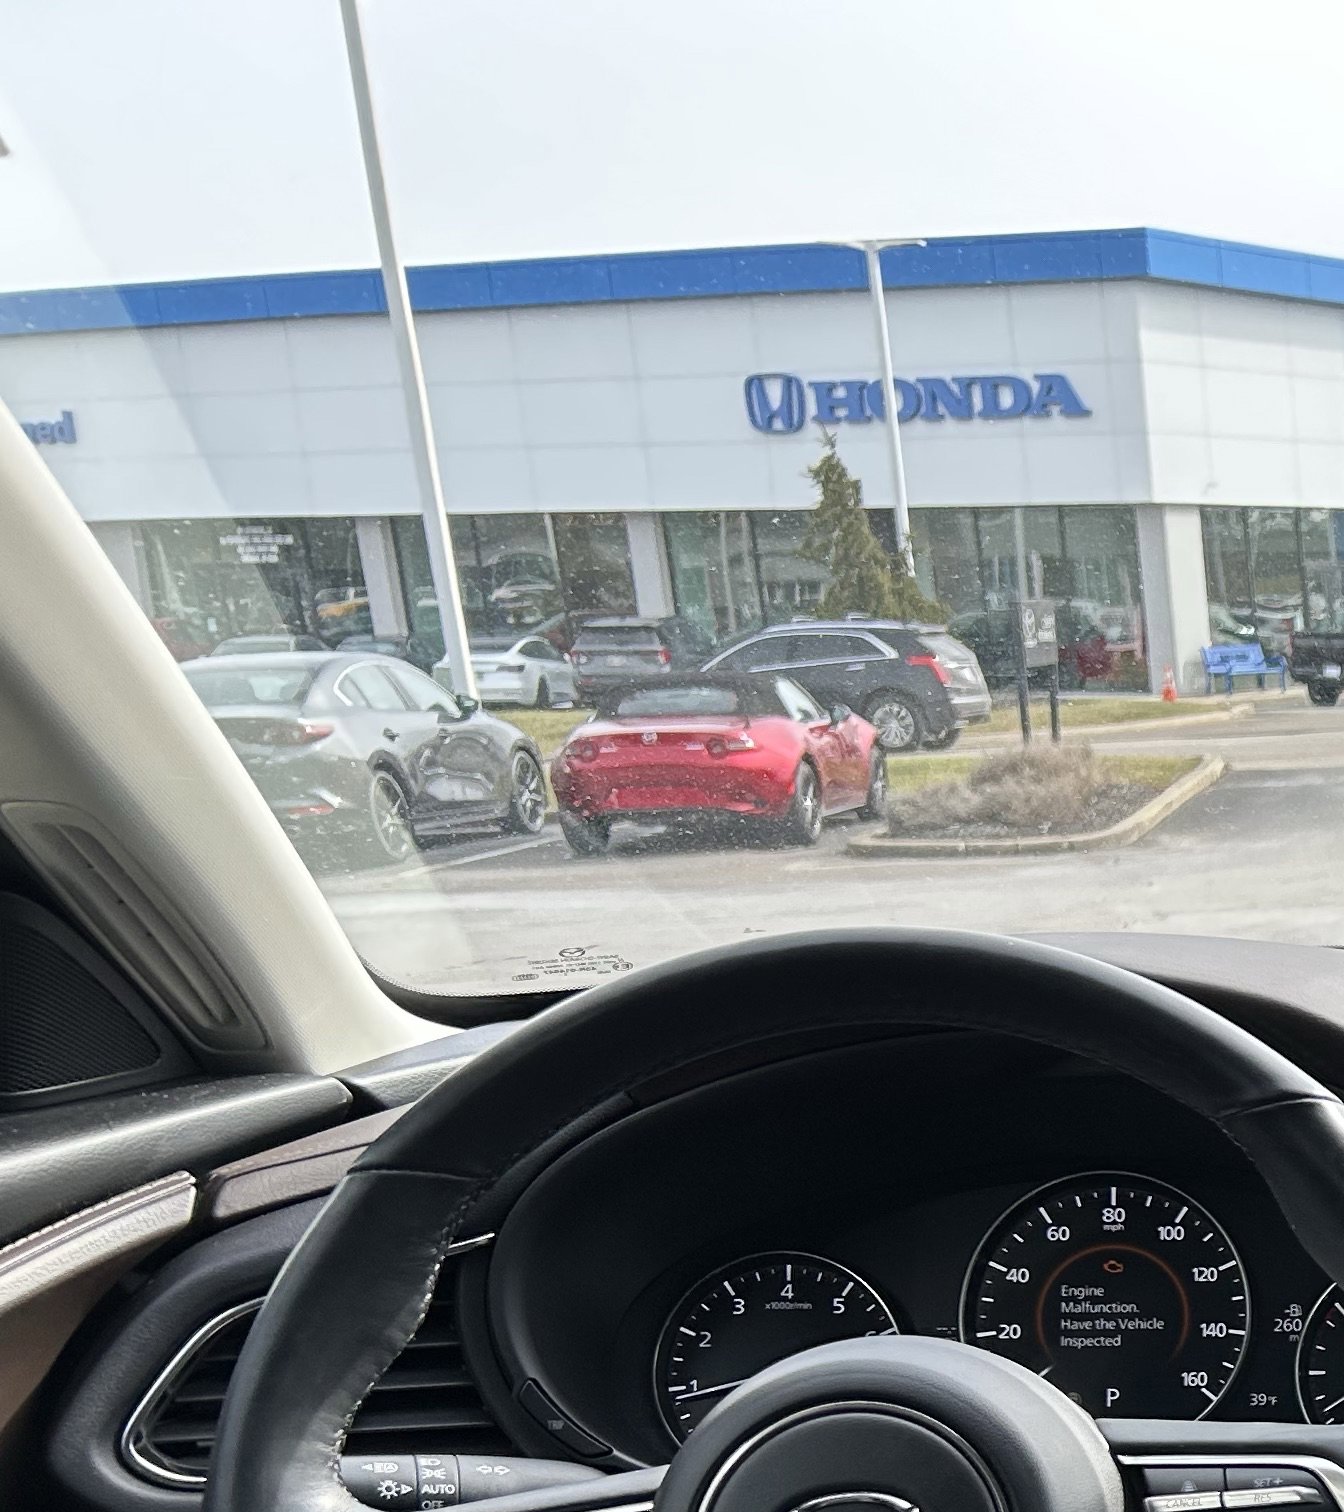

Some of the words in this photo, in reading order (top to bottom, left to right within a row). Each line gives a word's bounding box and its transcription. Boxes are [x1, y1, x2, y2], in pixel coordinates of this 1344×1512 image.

[807, 374, 1092, 424] HONDA
[1102, 1208, 1126, 1223] 80
[1046, 1226, 1070, 1241] 60
[1103, 1222, 1125, 1232] mph
[1157, 1226, 1185, 1241] 100
[1005, 1268, 1030, 1283] 40
[1191, 1267, 1219, 1282] 120
[780, 1283, 795, 1300] 4
[1060, 1284, 1105, 1300] Engine
[731, 1298, 745, 1315] 3
[832, 1298, 845, 1314] 5
[1060, 1301, 1140, 1314] Malfunction.
[997, 1324, 1022, 1340] 20
[1060, 1318, 1093, 1331] Have
[1095, 1318, 1116, 1331] the
[1118, 1318, 1165, 1331] Vehicle
[1199, 1322, 1227, 1338] 140
[1273, 1319, 1302, 1333] 260
[698, 1331, 712, 1348] 2
[1060, 1334, 1122, 1350] Inspected
[689, 1379, 698, 1393] 1
[1180, 1372, 1208, 1387] 160
[1105, 1387, 1120, 1408] P
[420, 1483, 456, 1496] AUTO
[421, 1500, 445, 1511] OFF
